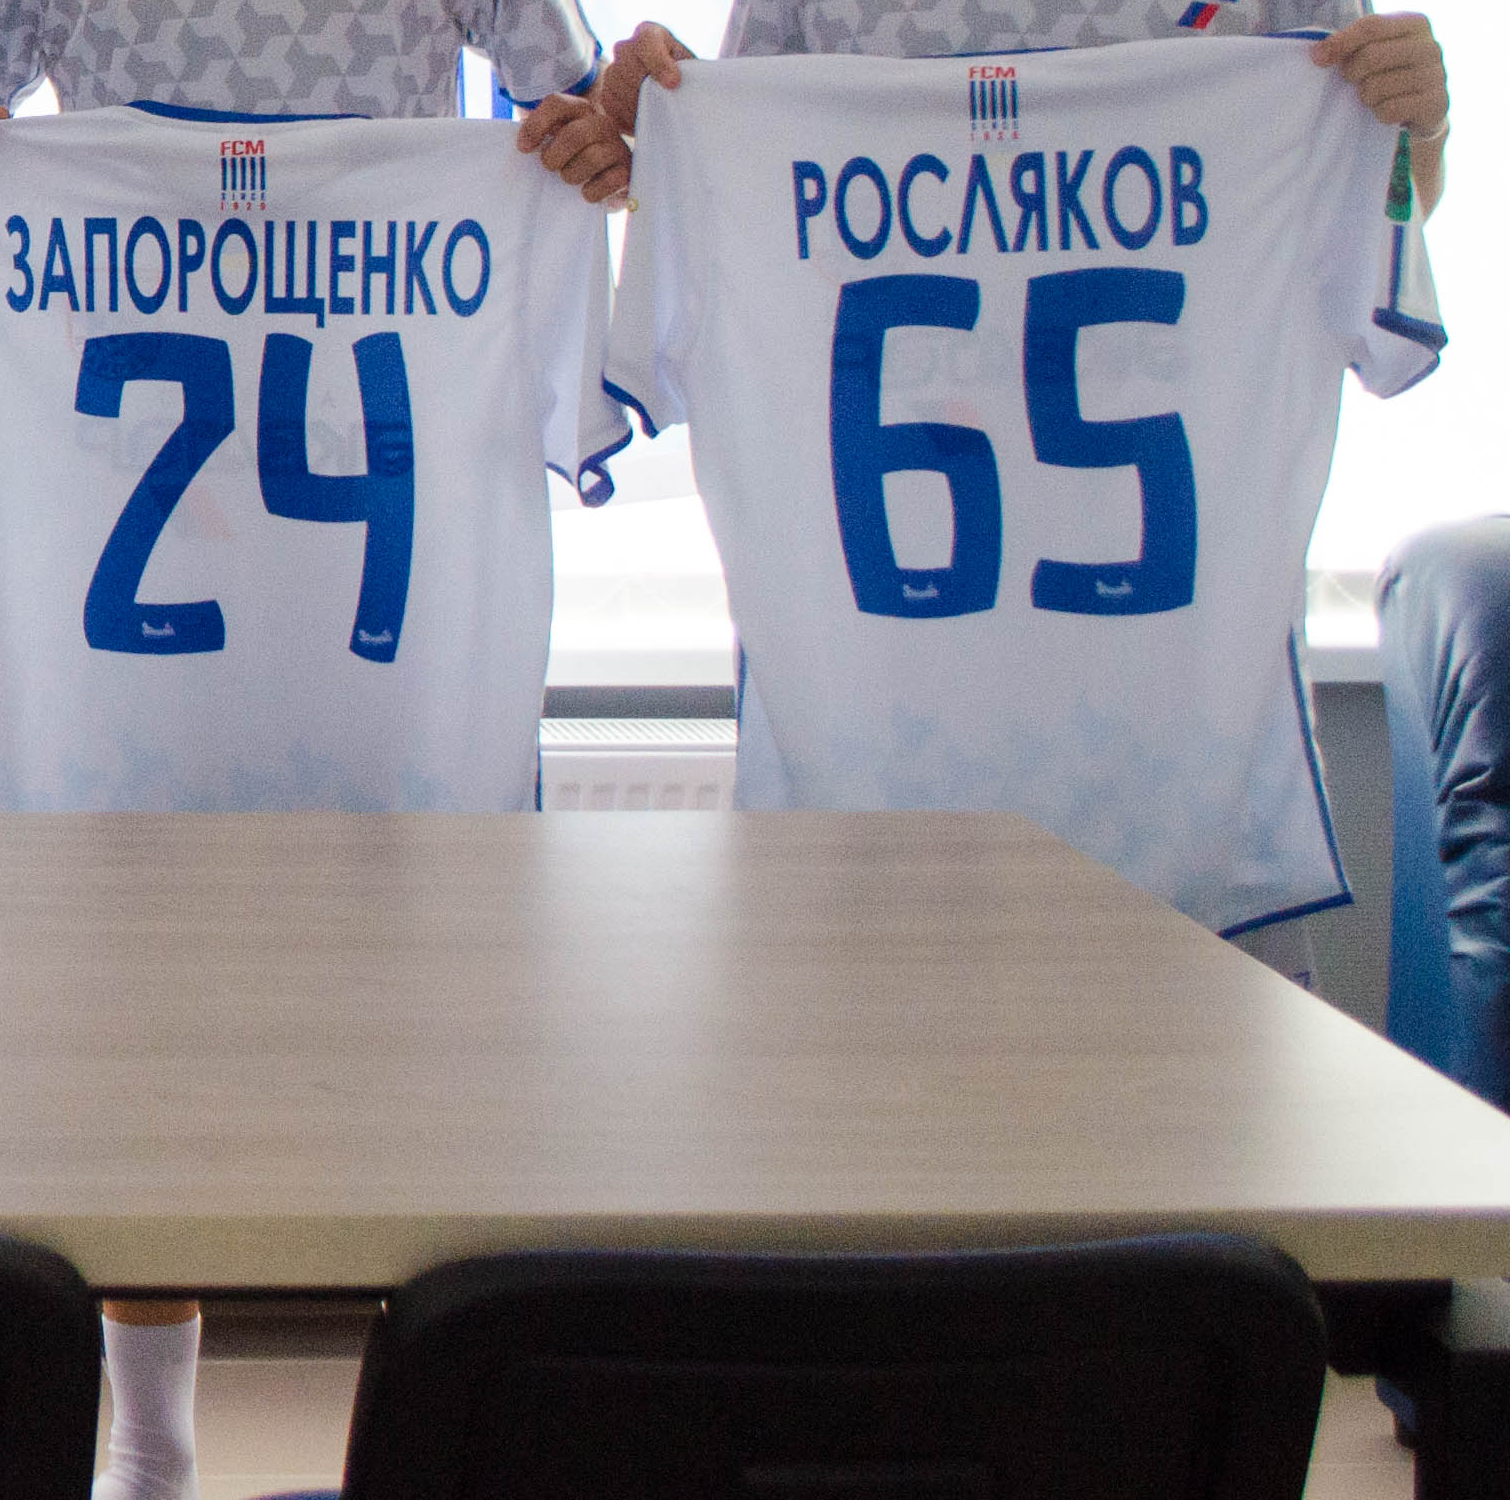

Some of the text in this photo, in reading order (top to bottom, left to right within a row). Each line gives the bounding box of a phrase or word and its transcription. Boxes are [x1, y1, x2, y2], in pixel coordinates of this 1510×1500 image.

[968, 66, 1016, 79] FCM
[220, 140, 265, 156] FCM
[793, 145, 1210, 261] РОСЛЯКОВ
[5, 214, 492, 329] ЗАПОРОЩЕНКО
[74, 332, 415, 664] 24
[830, 267, 1199, 619] 65
